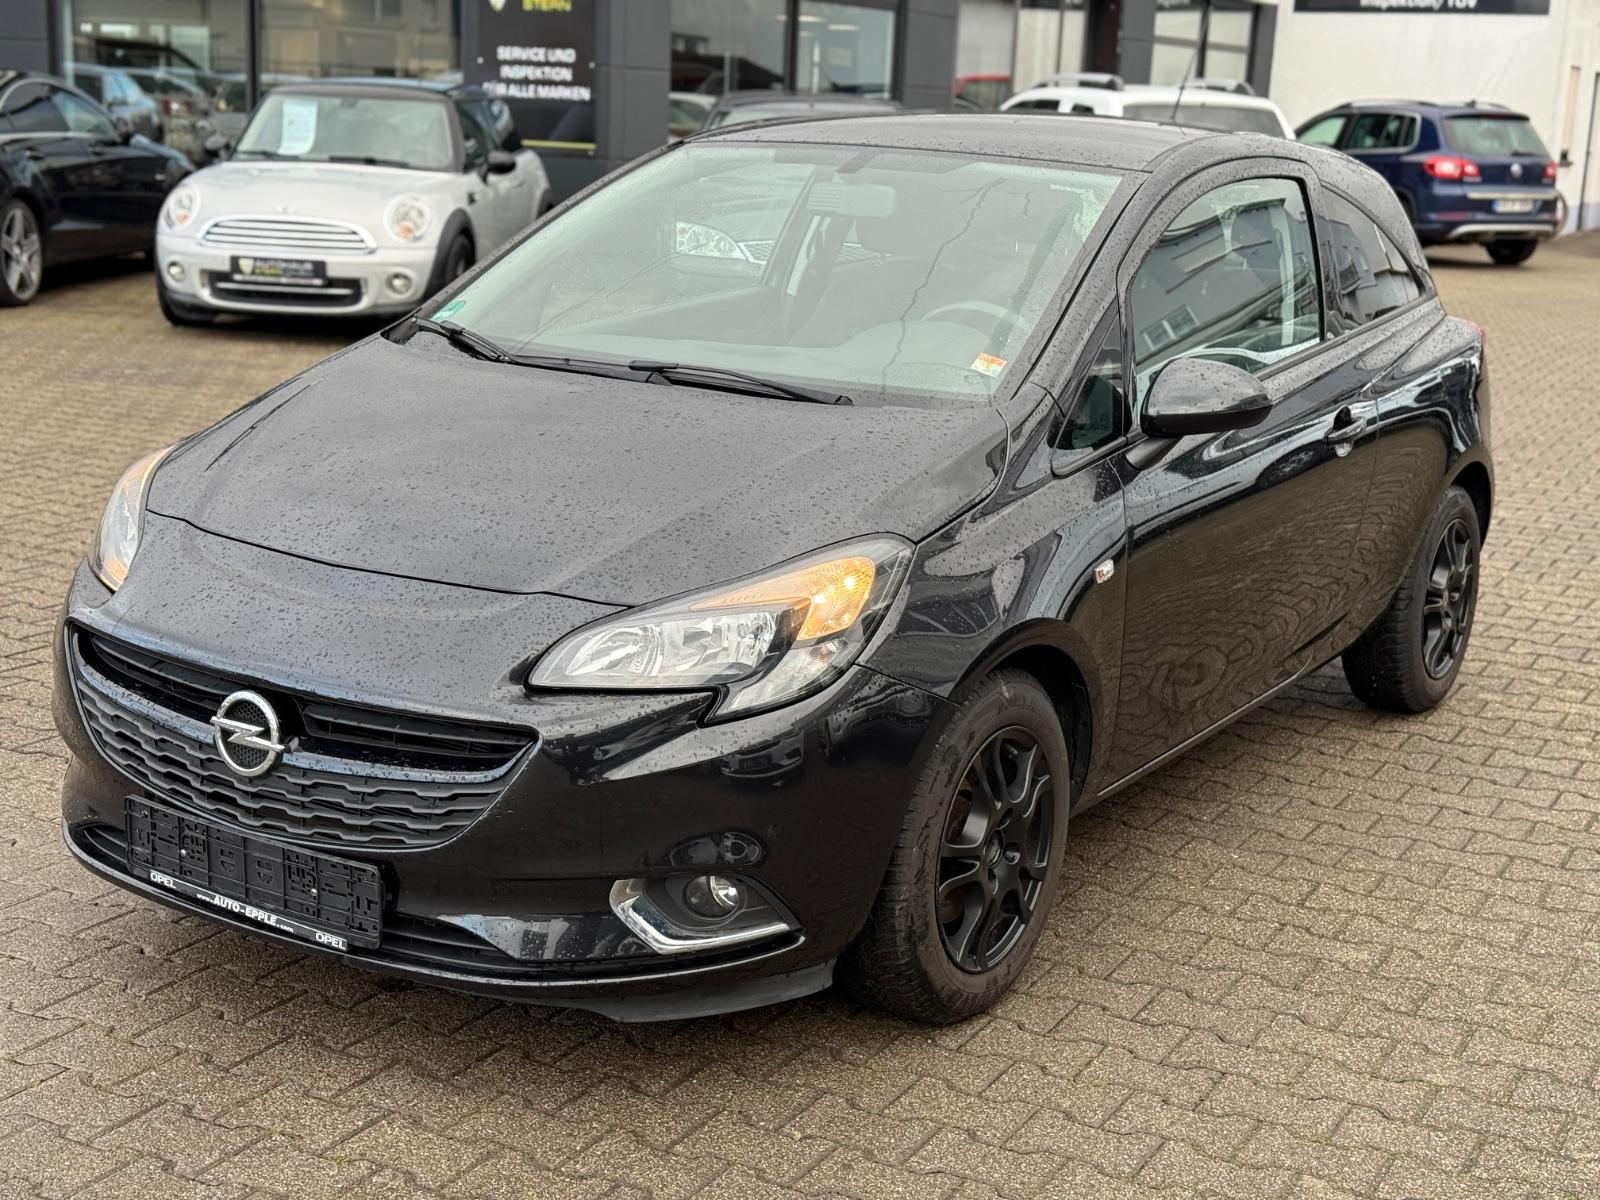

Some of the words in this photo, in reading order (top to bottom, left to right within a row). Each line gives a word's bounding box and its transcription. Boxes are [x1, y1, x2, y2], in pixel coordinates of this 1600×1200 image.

[497, 46, 546, 62] SERVICE
[547, 48, 576, 63] UND
[500, 65, 573, 82] INSPEKTION
[508, 83, 536, 99] ALLE
[537, 85, 591, 101] MARKEN
[150, 871, 177, 889] OPEL
[196, 893, 294, 933] www.AUTO-EPPLE.com
[315, 932, 347, 951] OPEL
